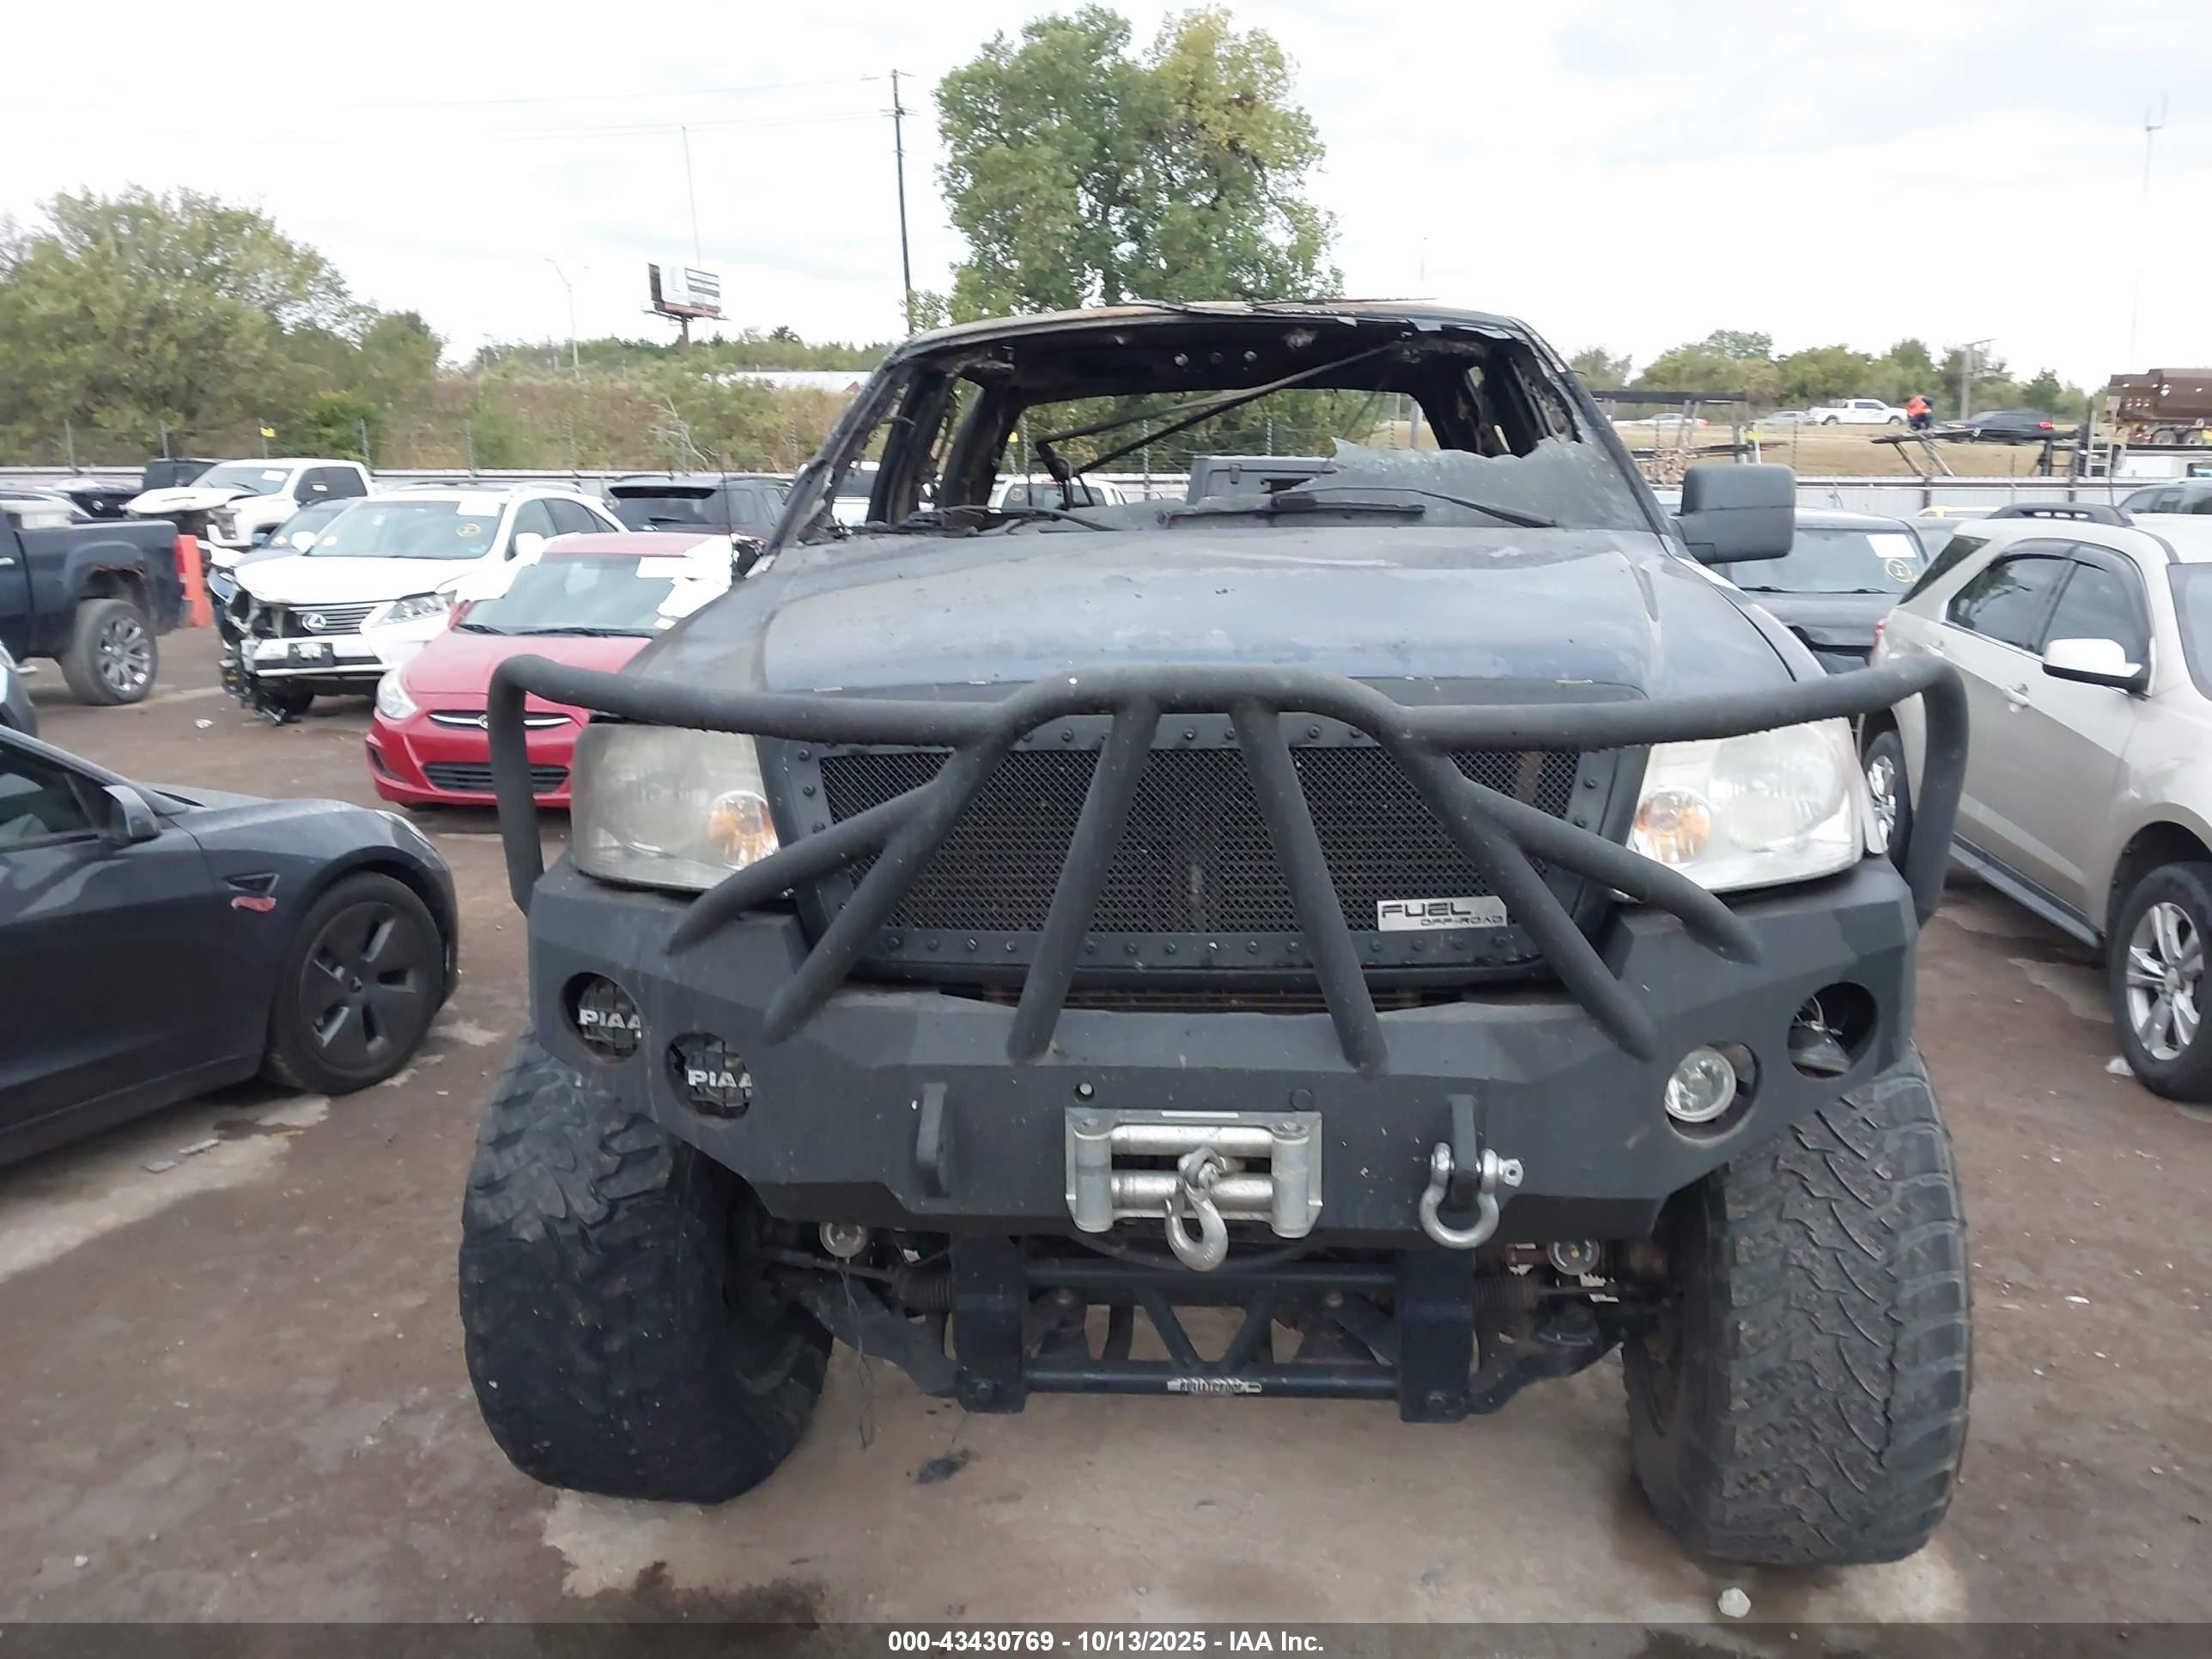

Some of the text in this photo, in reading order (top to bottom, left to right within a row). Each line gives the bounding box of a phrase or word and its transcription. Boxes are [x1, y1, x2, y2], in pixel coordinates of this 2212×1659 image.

[1382, 902, 1472, 918] FUEL
[578, 1008, 641, 1030] PIAA
[687, 1069, 753, 1088] PIAA
